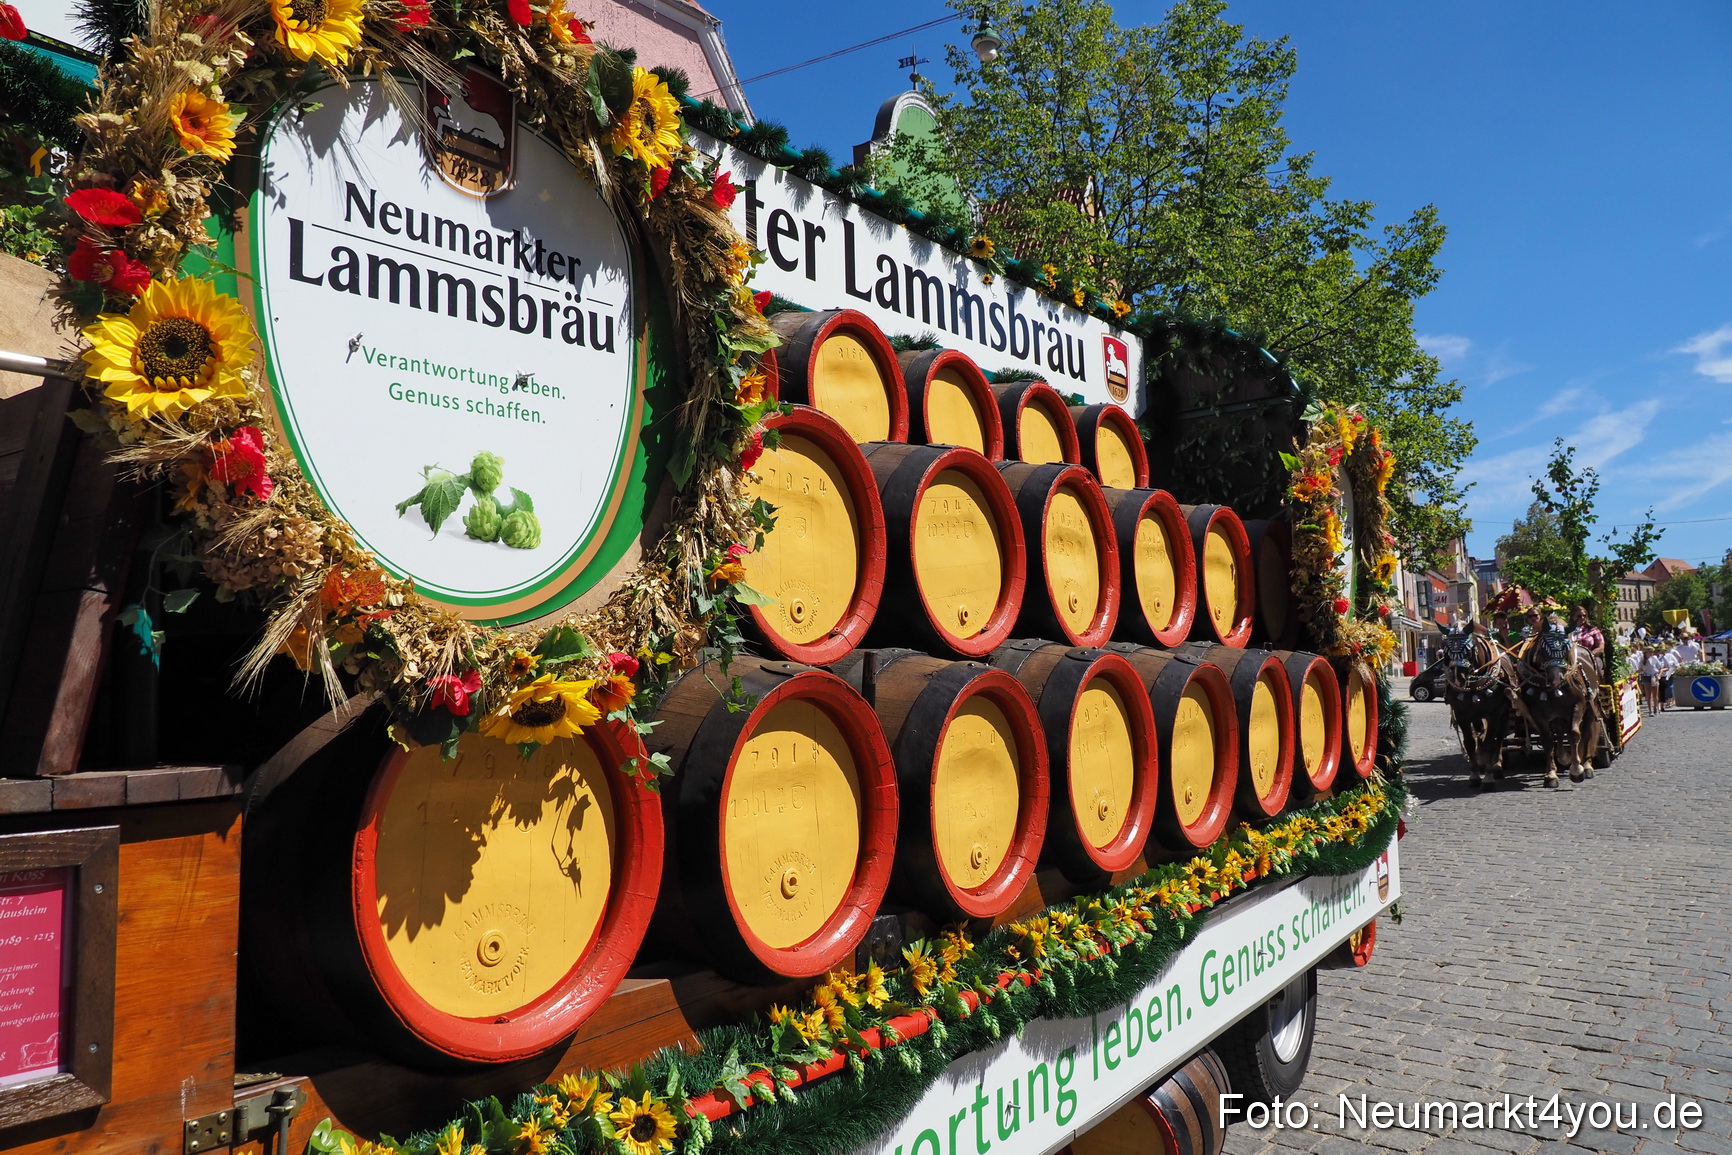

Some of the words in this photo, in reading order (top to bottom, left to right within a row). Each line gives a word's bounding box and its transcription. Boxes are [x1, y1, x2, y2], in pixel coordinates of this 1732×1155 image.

[449, 159, 491, 186] 1628
[344, 180, 582, 285] Neumarkter
[287, 216, 616, 354] Lammsbräu
[745, 180, 826, 282] ter
[842, 217, 1087, 383] Lammsbräu
[362, 345, 510, 395] Verantwortung
[514, 373, 566, 400] leben.
[1112, 385, 1125, 399] 1628
[388, 382, 460, 410] Genuss
[466, 397, 547, 424] schaffen.
[768, 467, 827, 496] 7934
[0, 896, 13, 906] tr.
[17, 896, 24, 906] 7
[33, 932, 55, 942] 1213
[895, 1044, 1078, 1155] ortung
[1091, 983, 1193, 1082] leben.
[1199, 923, 1286, 1008] Genuss
[1292, 875, 1366, 951] schaffen.
